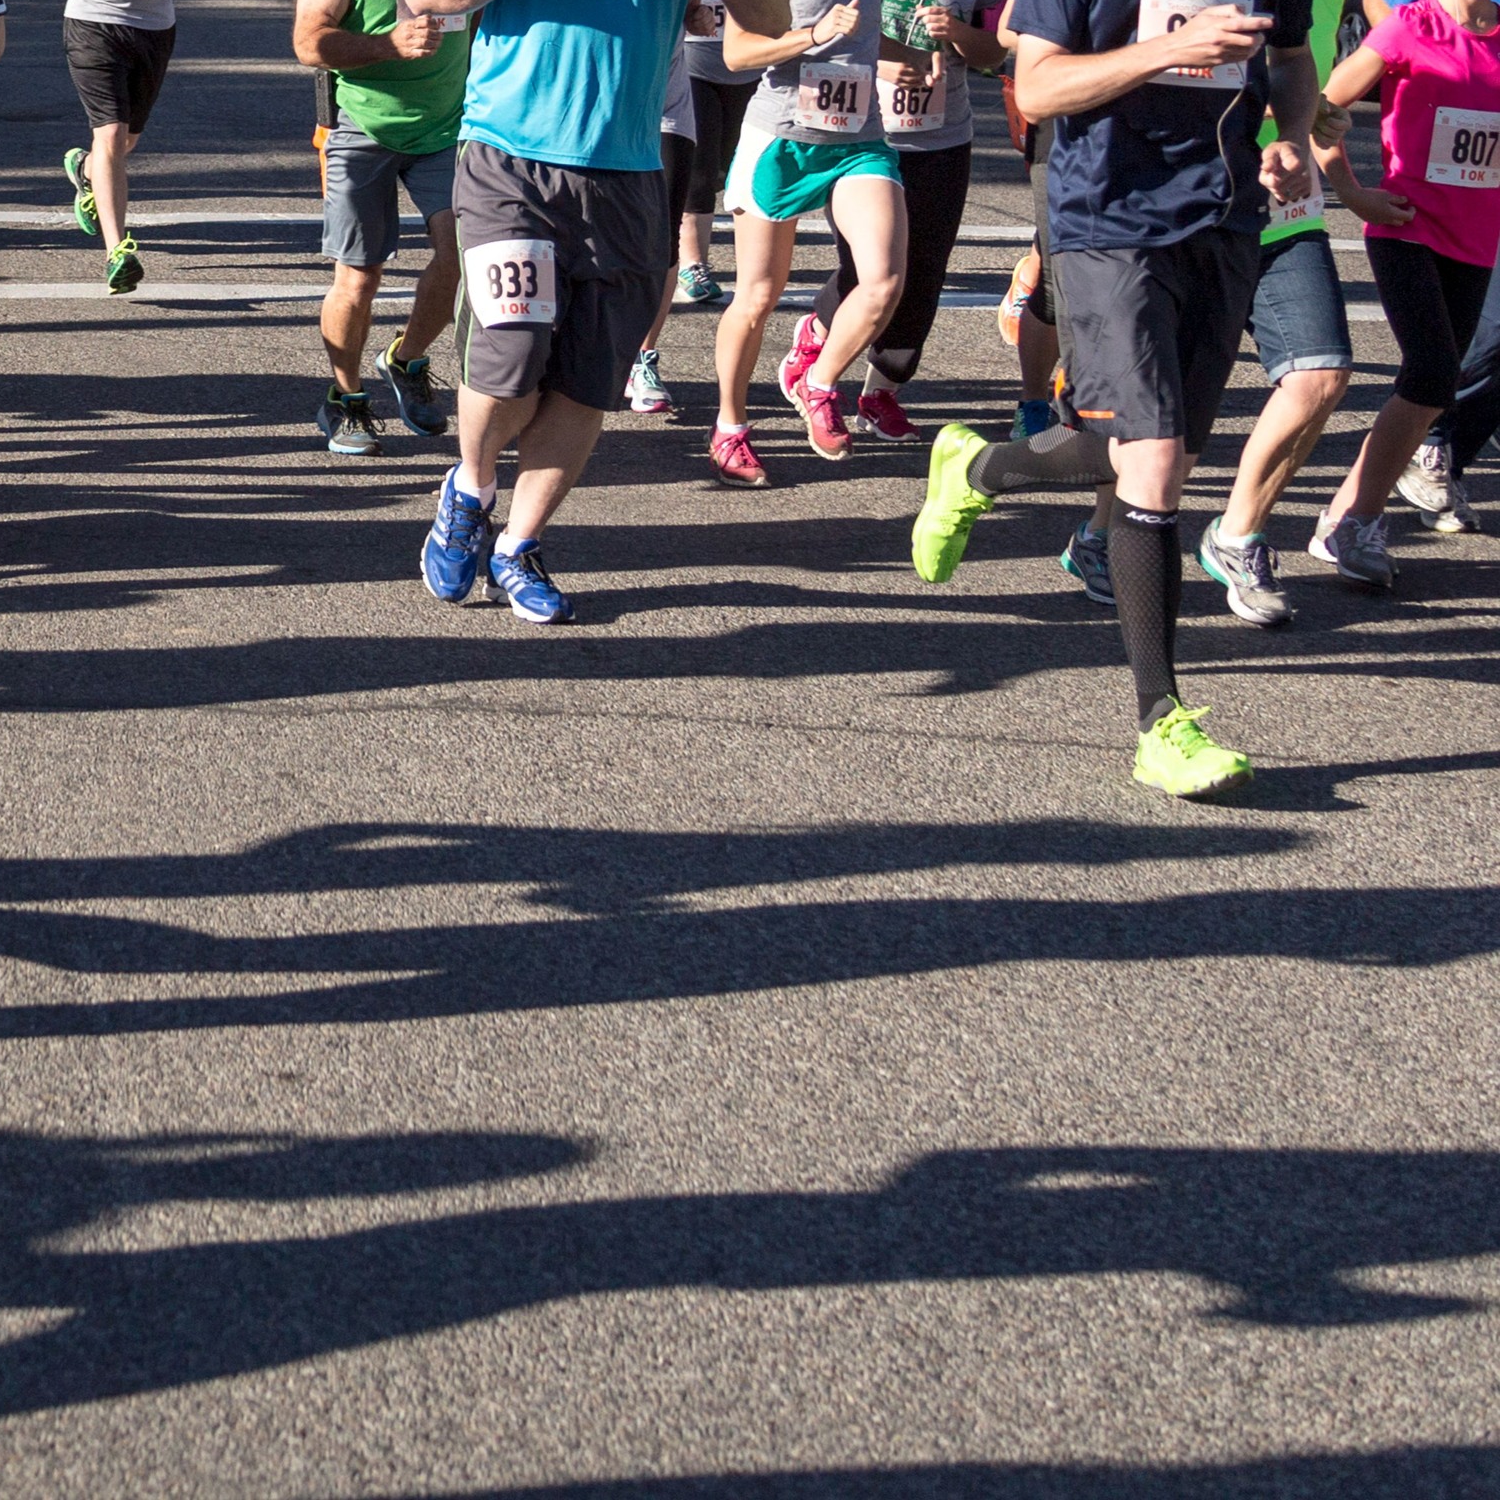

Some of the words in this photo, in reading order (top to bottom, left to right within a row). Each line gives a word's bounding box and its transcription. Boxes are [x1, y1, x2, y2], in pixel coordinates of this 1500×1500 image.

[817, 79, 857, 113] 841
[892, 87, 933, 115] 867
[823, 115, 849, 126] 10K
[900, 118, 922, 128] 10K
[1452, 129, 1499, 167] 807
[1460, 169, 1485, 181] 10K
[1284, 204, 1307, 220] 10K
[487, 260, 538, 299] 833
[501, 303, 531, 315] 10K
